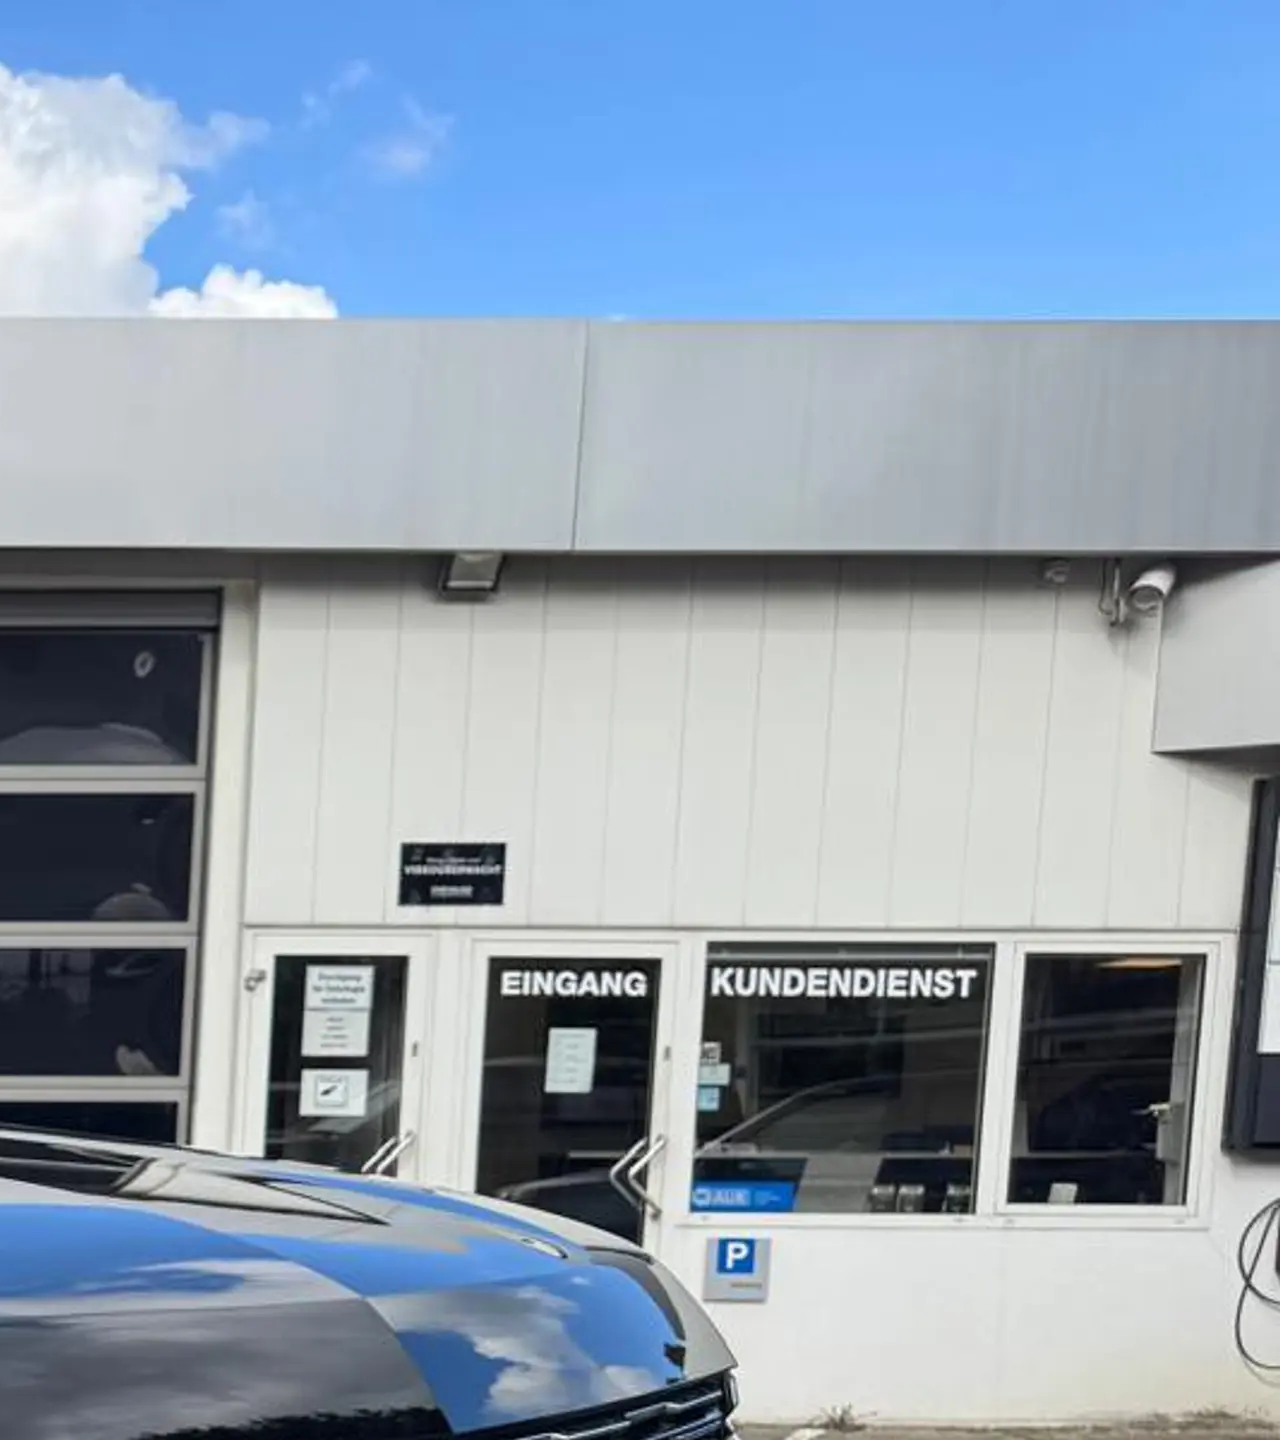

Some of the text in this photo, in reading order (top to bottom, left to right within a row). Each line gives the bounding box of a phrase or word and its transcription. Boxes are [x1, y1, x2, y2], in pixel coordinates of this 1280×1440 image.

[500, 971, 647, 997] EINGANG
[711, 967, 978, 998] KUNDENDIENST
[724, 1241, 749, 1270] P
